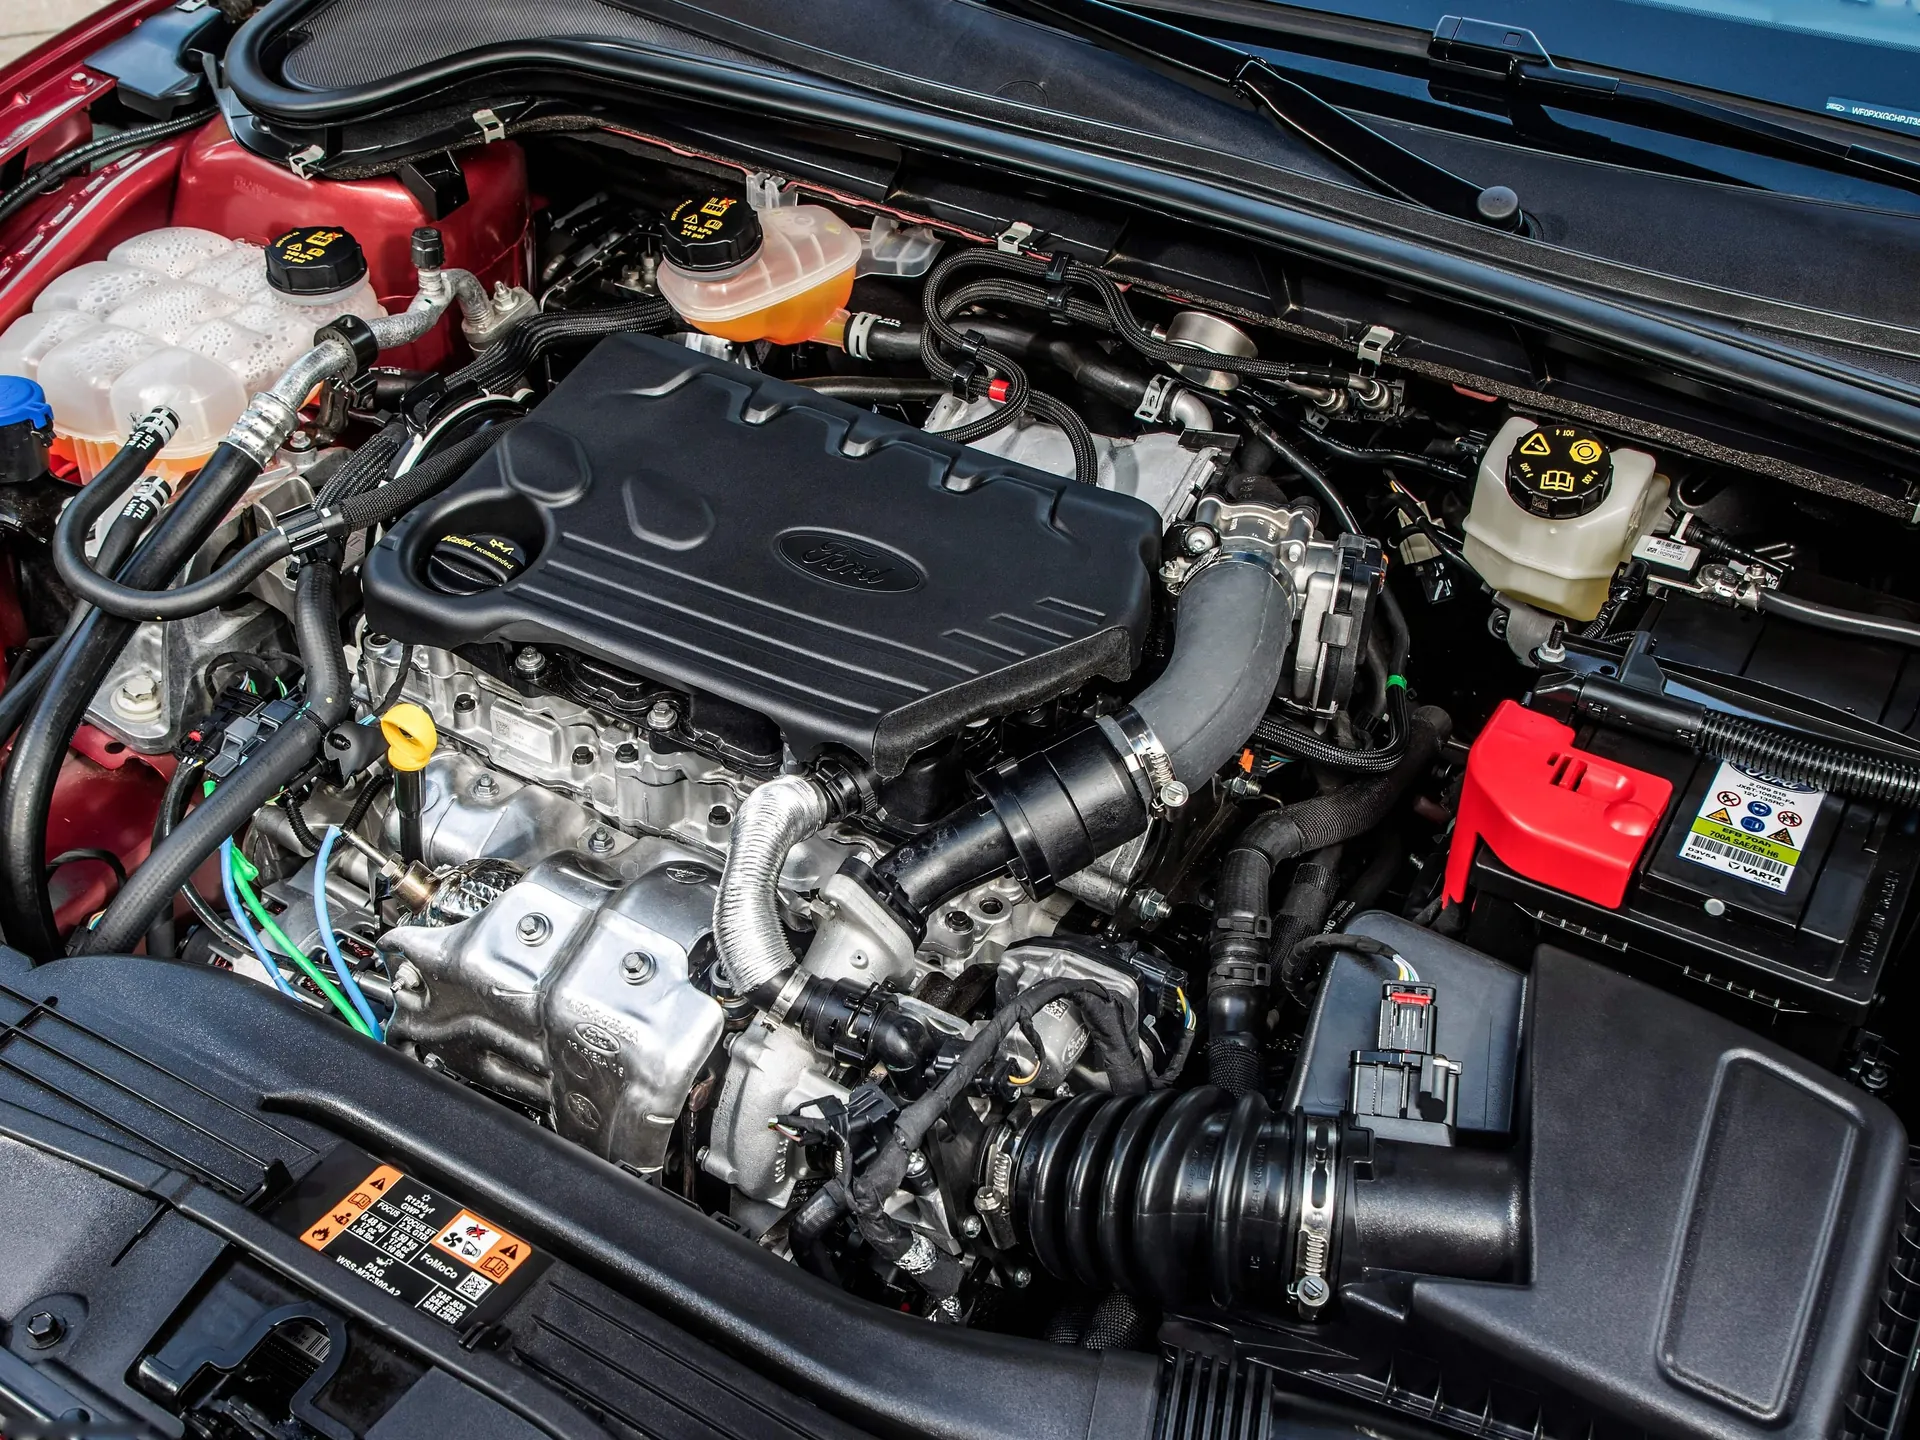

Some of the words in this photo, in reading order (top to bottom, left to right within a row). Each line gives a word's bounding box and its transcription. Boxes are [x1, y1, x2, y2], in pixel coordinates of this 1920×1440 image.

[126, 431, 145, 447] UPR
[137, 434, 155, 450] BTL
[1562, 429, 1575, 437] DOT
[122, 498, 140, 517] LWR
[132, 502, 150, 520] BTL
[473, 545, 515, 570] recommended
[801, 541, 896, 584] Ford
[1743, 790, 1758, 798] 12V
[1709, 830, 1731, 843] 700A
[1732, 838, 1765, 855] SAE/EN
[1766, 850, 1779, 859] H6
[1722, 827, 1743, 838] EFB
[1745, 834, 1772, 848] 70Ah
[1742, 865, 1782, 884] VARTA
[377, 1201, 401, 1218] FOCUS
[400, 1202, 420, 1217] GWP
[404, 1194, 436, 1214] R1234yf
[351, 1224, 366, 1237] 1.06
[363, 1230, 375, 1241] lbs
[360, 1213, 377, 1226] 0.48
[375, 1222, 388, 1233] kg
[367, 1227, 377, 1235] oz
[398, 1222, 412, 1233] 2.3L
[411, 1228, 430, 1242] GTDI
[403, 1216, 426, 1232] FOCUS
[424, 1228, 437, 1237] ST
[389, 1237, 402, 1248] 17.6
[400, 1245, 411, 1254] oz
[391, 1230, 409, 1243] 0.50
[406, 1239, 419, 1251] kg
[381, 1242, 397, 1255] 1.10
[394, 1249, 406, 1260] lbs
[364, 1262, 386, 1278] PAG
[420, 1252, 458, 1279] FoMoCo
[422, 1300, 439, 1313] SAE
[428, 1295, 445, 1308] SAE
[442, 1303, 463, 1319] J2842
[435, 1290, 452, 1303] SAE
[449, 1299, 467, 1312] J639
